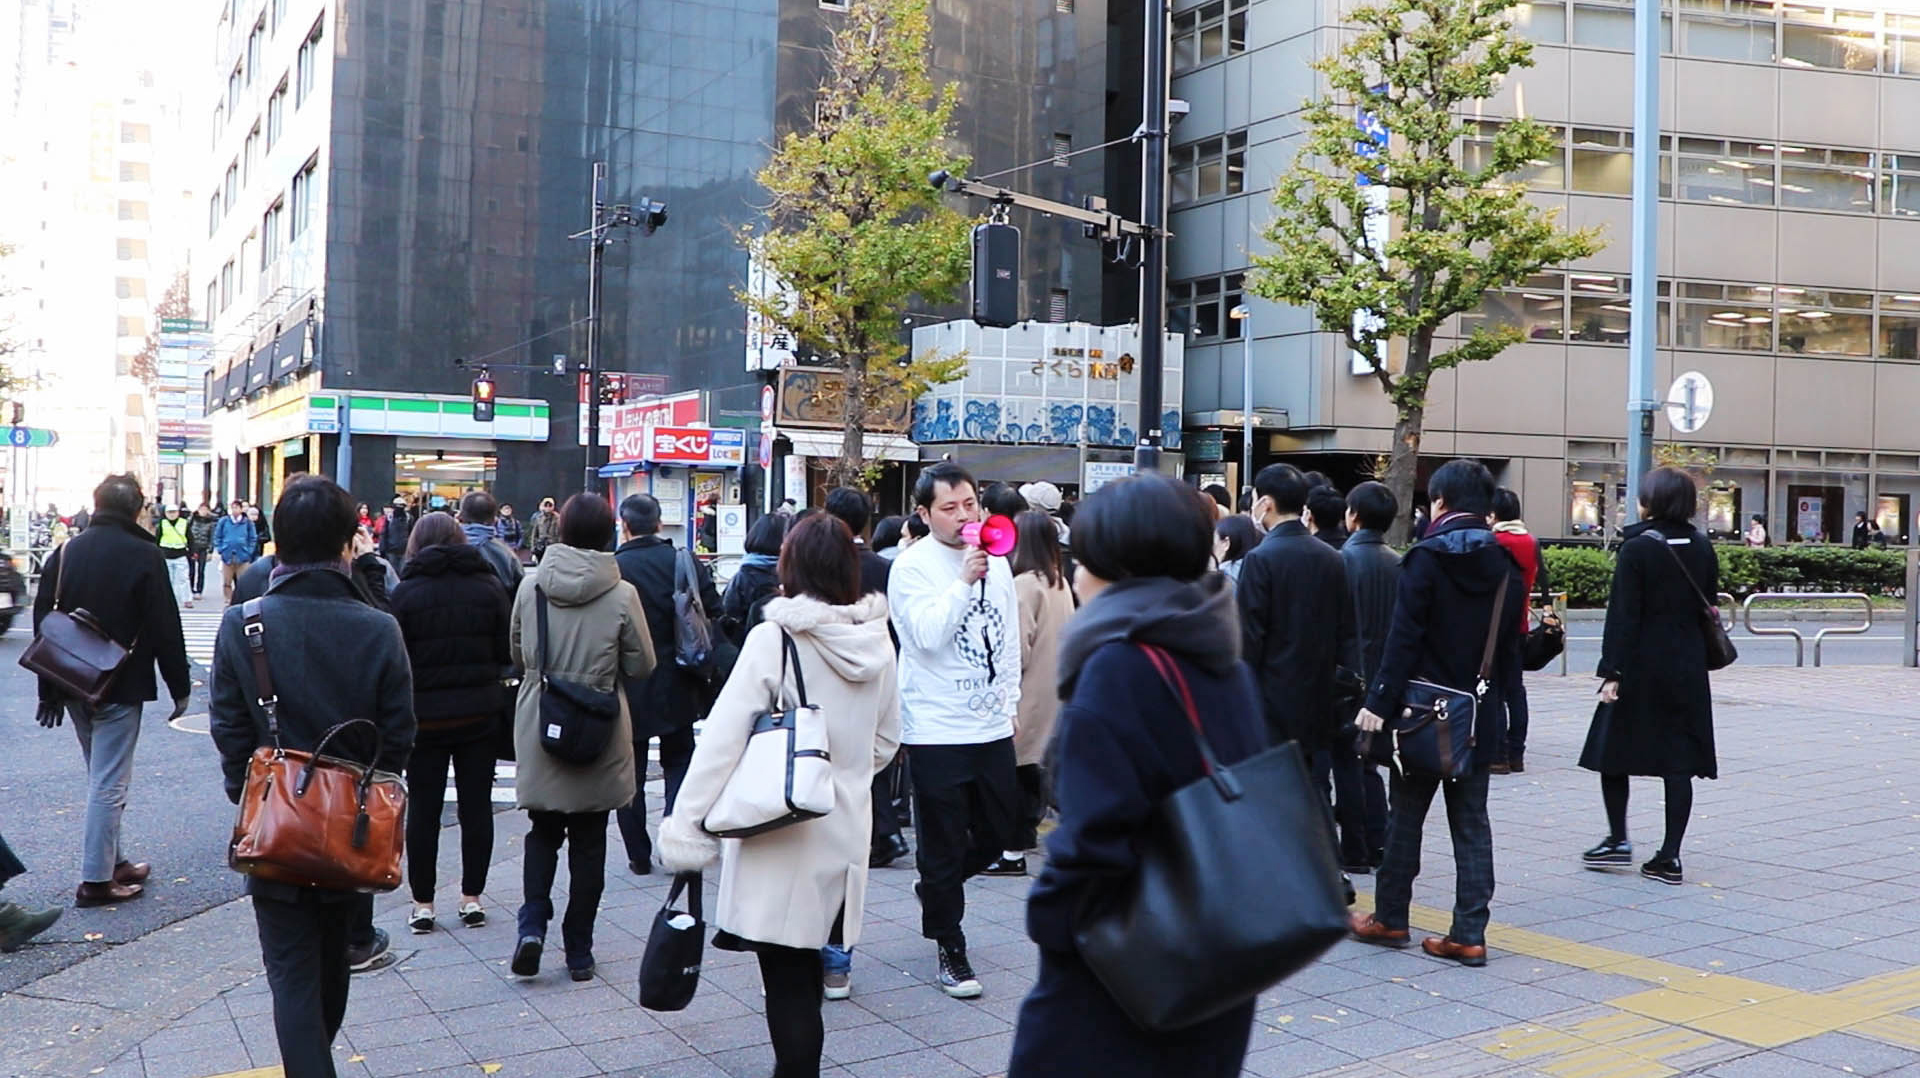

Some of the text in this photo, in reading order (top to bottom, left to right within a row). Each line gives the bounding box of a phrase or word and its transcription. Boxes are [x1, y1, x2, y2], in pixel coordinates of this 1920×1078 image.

[15, 429, 25, 444] 8
[613, 430, 641, 459] 宝くじ
[655, 434, 708, 454] 宝くじ
